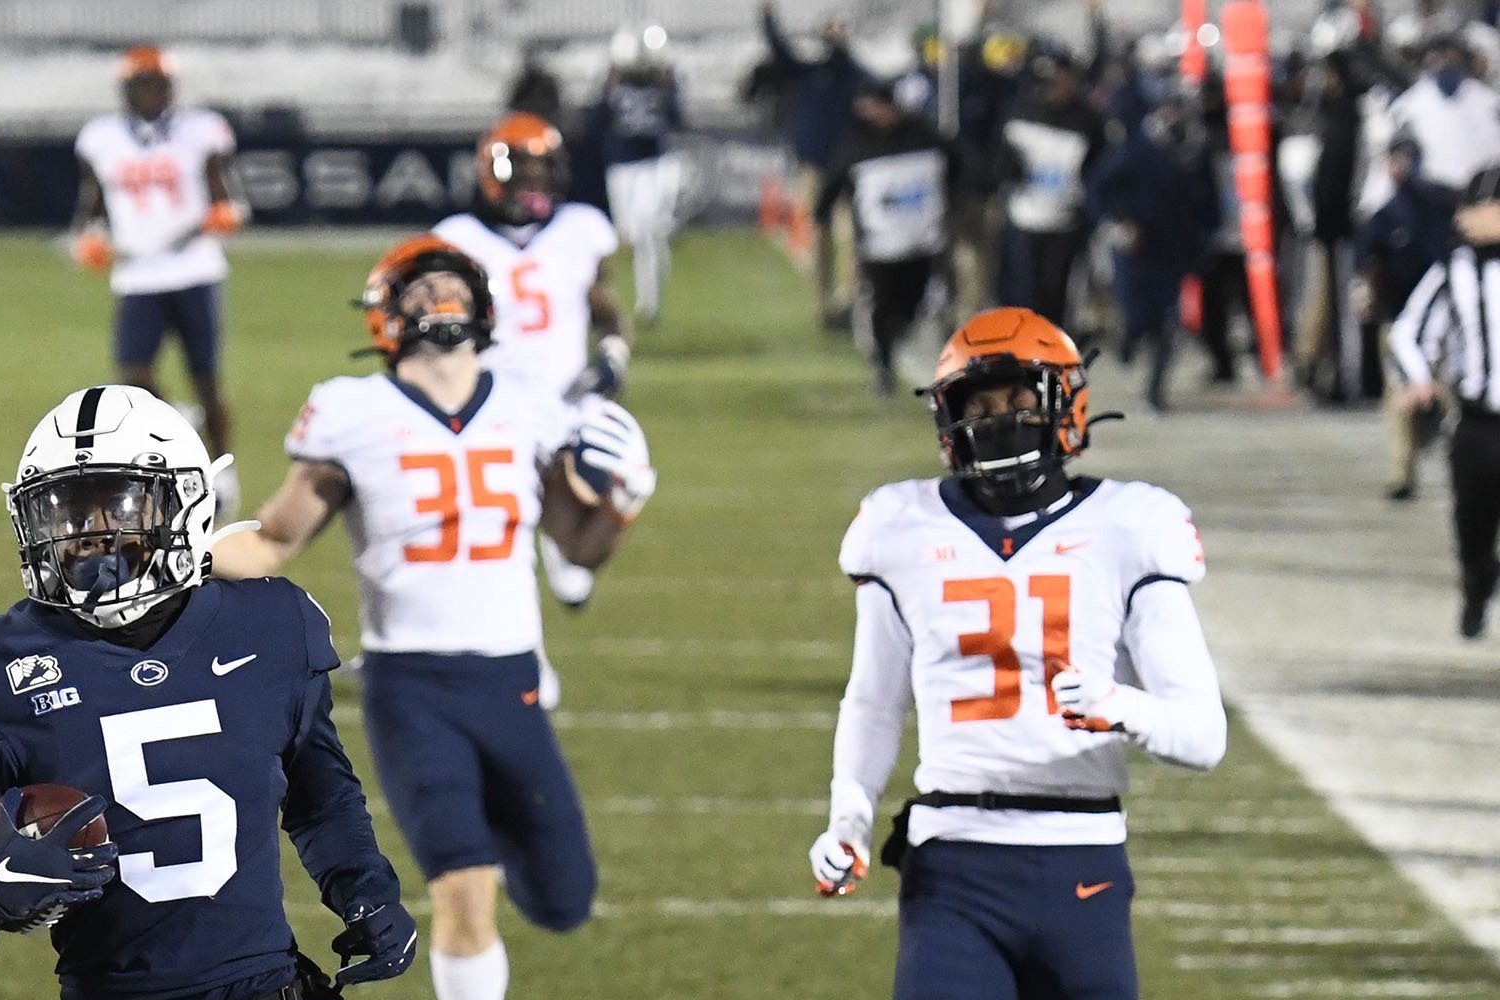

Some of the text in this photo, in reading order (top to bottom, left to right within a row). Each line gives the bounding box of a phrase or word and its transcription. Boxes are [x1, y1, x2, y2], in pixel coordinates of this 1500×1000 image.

[508, 261, 552, 333] 5
[399, 448, 520, 562] 35
[942, 574, 1073, 723] 31
[100, 698, 238, 903] 5
